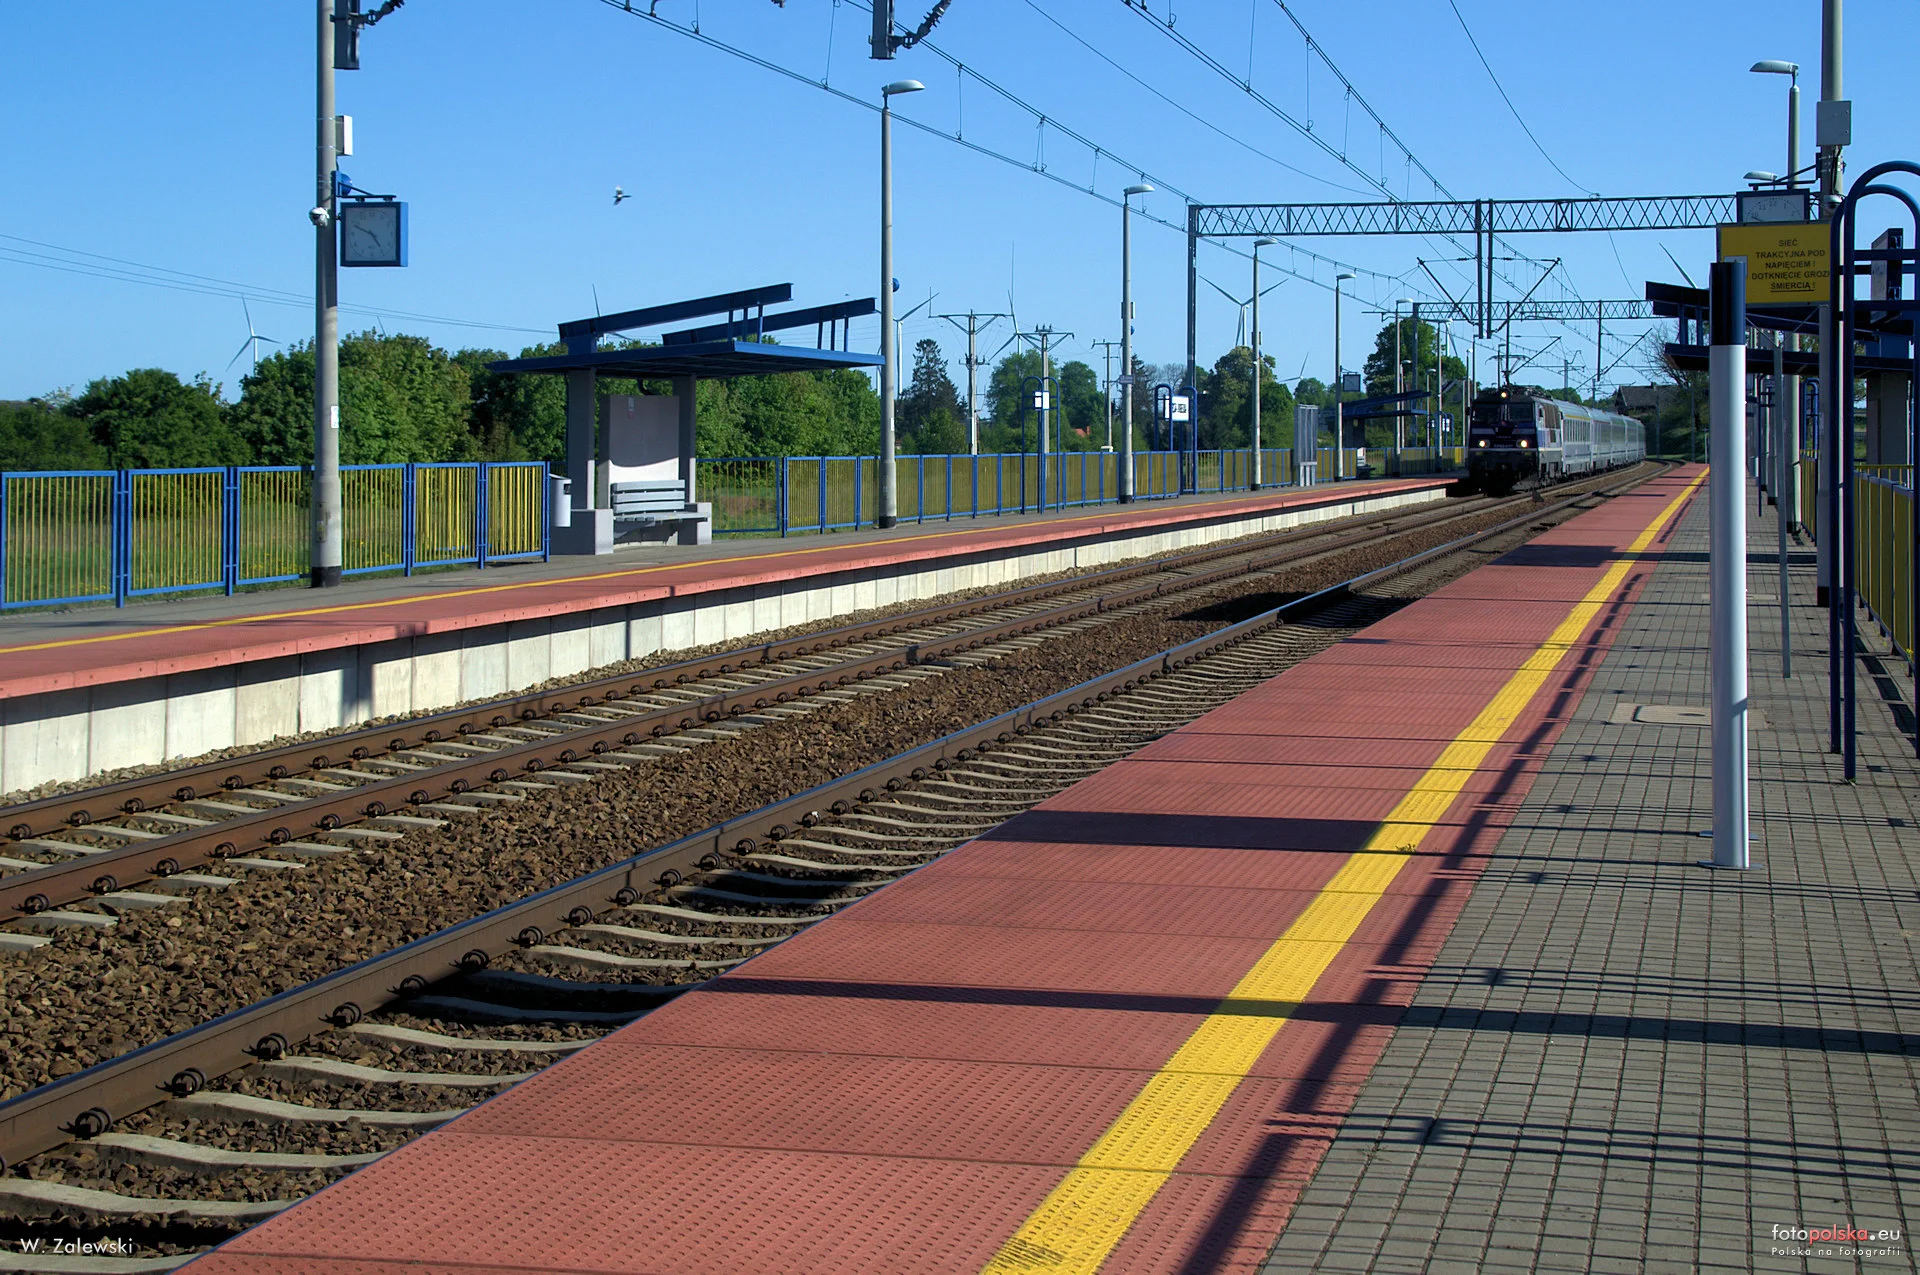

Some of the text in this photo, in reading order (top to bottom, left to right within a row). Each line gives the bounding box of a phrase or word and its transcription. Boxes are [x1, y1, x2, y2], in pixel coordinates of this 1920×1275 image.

[1778, 237, 1798, 247] SIEĆ
[1755, 249, 1826, 259] TRAKCYJNA POD
[1765, 261, 1811, 270] NAPIĘCIEM
[1751, 271, 1802, 281] DOTKNIĘCIE
[1770, 281, 1811, 290] ŚMIERCIĄ
